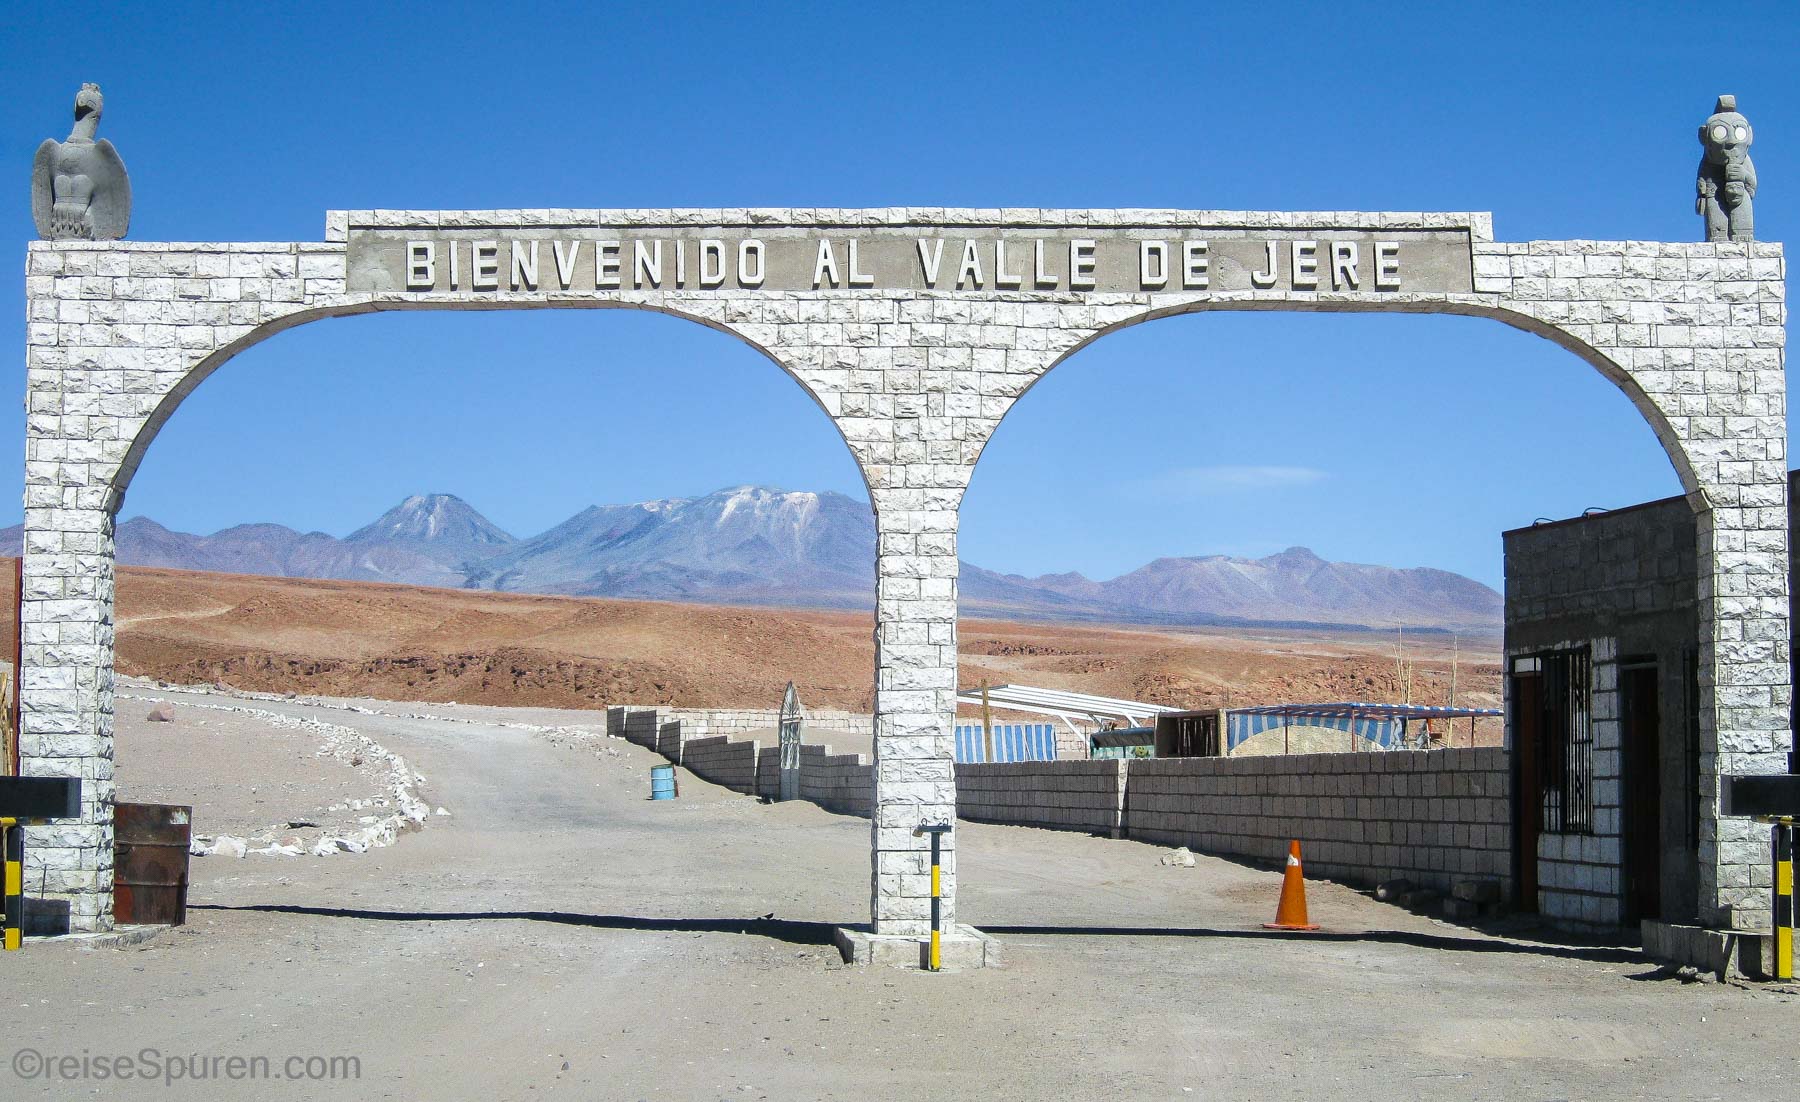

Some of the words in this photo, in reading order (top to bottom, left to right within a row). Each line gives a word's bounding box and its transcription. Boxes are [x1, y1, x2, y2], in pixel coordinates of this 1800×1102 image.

[406, 239, 765, 289] BIENVENIDO
[813, 239, 875, 289] AL
[917, 239, 1096, 288] VALLE
[1140, 240, 1208, 288] DE
[1251, 240, 1401, 289] JERE
